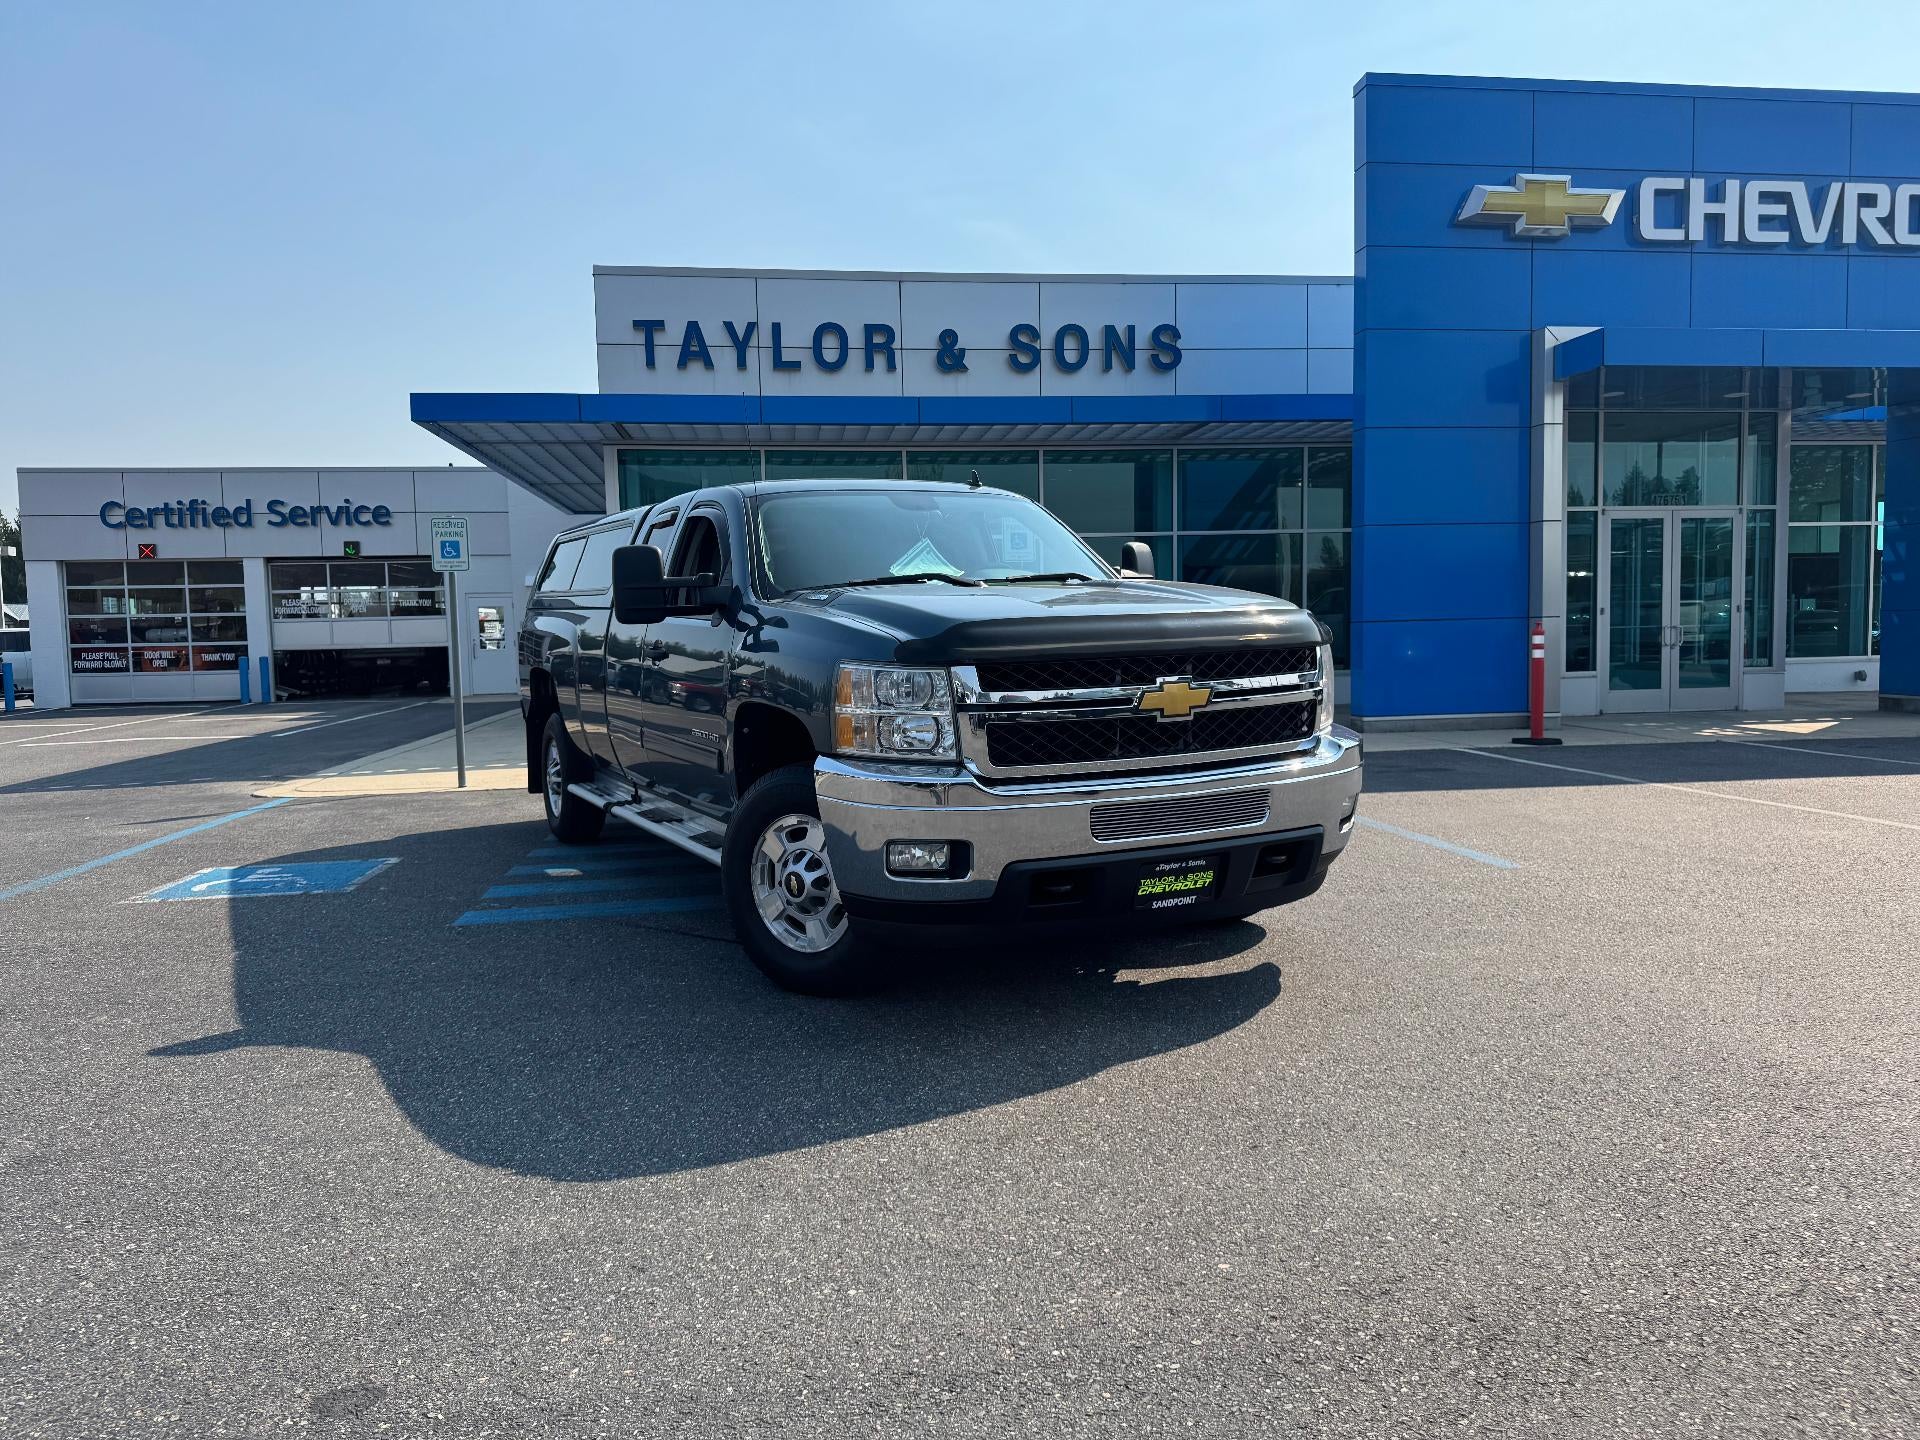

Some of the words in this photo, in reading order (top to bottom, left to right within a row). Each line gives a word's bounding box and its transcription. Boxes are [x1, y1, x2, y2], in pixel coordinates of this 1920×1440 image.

[632, 319, 897, 373] TAYLOR
[936, 328, 968, 374] &
[1008, 323, 1183, 374] SONS
[100, 498, 252, 530] Certified
[266, 498, 392, 528] Service
[433, 521, 465, 529] RESERVED
[435, 530, 464, 538] PARKING
[81, 652, 103, 660] PLEASE
[104, 652, 119, 660] PULL
[144, 651, 160, 659] DOOR
[161, 650, 176, 659] WILL
[201, 653, 221, 661] THANK
[222, 653, 236, 661] YOU!
[74, 660, 103, 668] FORWARD
[103, 659, 127, 668] SLOWLY
[152, 659, 168, 668] OPEN
[1159, 863, 1181, 871] Taylor
[1140, 876, 1175, 887] TAYLOR
[1187, 871, 1213, 881] SONS
[1137, 880, 1213, 895] CHEVROLET
[1151, 896, 1197, 909] SANDPOINT
